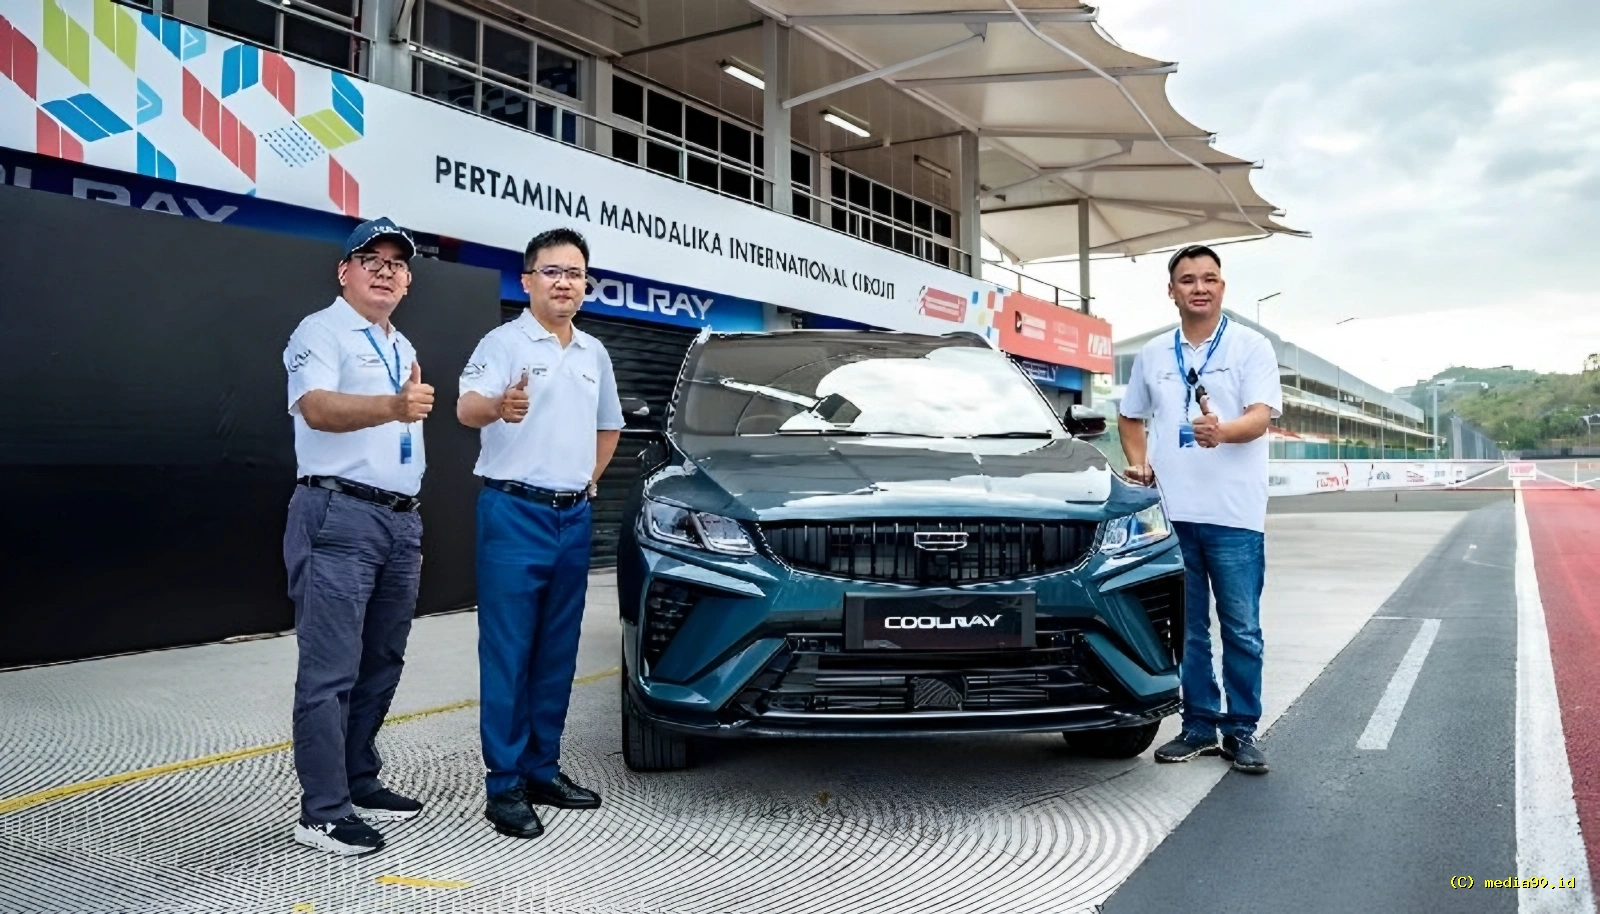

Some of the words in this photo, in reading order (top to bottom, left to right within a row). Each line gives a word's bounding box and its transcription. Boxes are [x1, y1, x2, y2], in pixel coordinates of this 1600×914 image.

[436, 155, 590, 222] PERTAMINA
[600, 201, 723, 256] MANDALIKA
[730, 237, 848, 288] INTERNATIONAL
[884, 614, 1003, 629] COOLRAY
